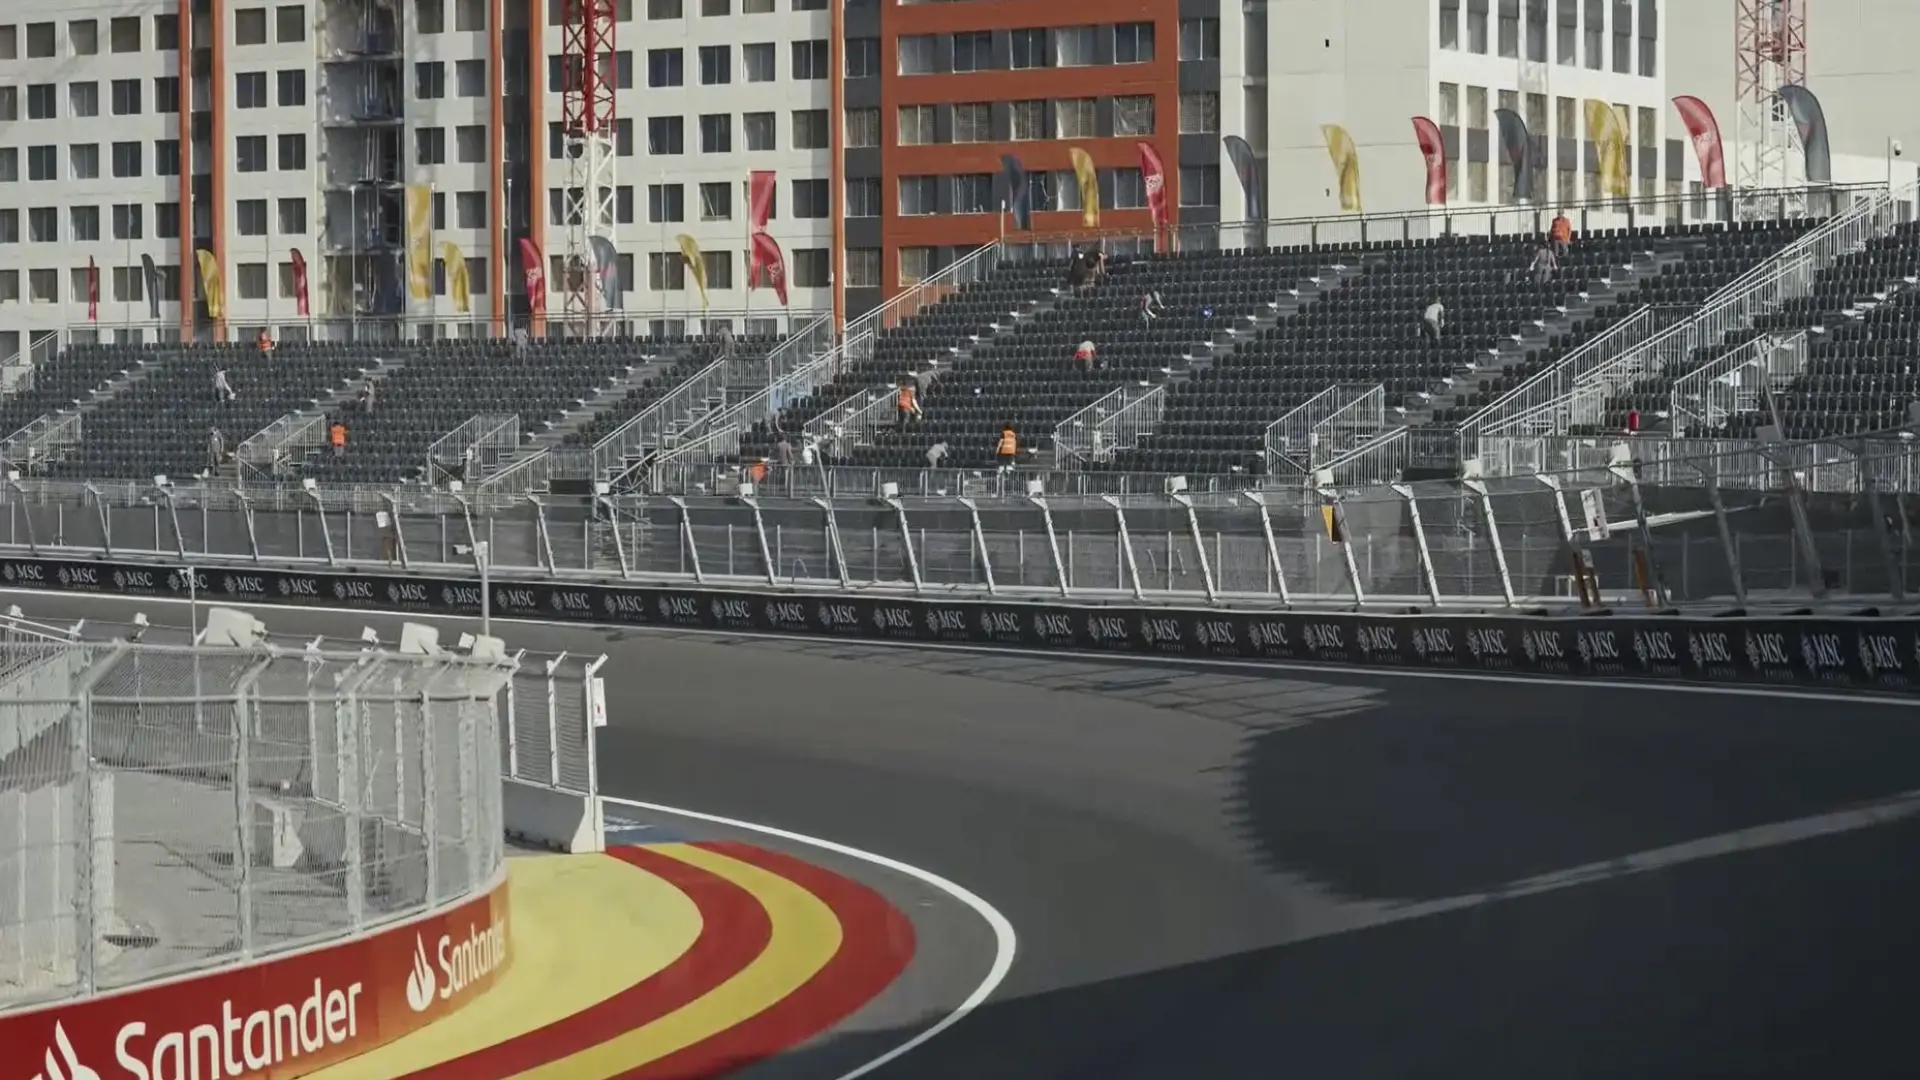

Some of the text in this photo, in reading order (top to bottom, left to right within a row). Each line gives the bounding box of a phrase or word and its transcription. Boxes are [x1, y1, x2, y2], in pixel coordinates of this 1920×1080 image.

[16, 565, 45, 580] MSC
[71, 567, 99, 583] MSC
[126, 571, 154, 586] MSC
[237, 577, 265, 592] MSC
[291, 579, 318, 594] MSC
[346, 581, 375, 597] MSC
[400, 584, 429, 600] MSC
[455, 587, 482, 604] MSC
[508, 590, 537, 606] MSC
[563, 592, 591, 609] MSC
[616, 595, 644, 612] MSC
[671, 597, 699, 615] MSC
[722, 600, 752, 618] MSC
[777, 603, 806, 621] MSC
[830, 605, 859, 624] MSC
[885, 608, 914, 627] MSC
[937, 610, 966, 629] MSC
[992, 612, 1021, 632] MSC
[1045, 614, 1074, 635] MSC
[1099, 617, 1128, 638] MSC
[1153, 619, 1182, 640] MSC
[1208, 621, 1236, 643] MSC
[1260, 622, 1289, 645] MSC
[1314, 624, 1344, 647] MSC
[1368, 626, 1398, 650] MSC
[1424, 628, 1455, 652] MSC
[1478, 629, 1509, 654] MSC
[1534, 630, 1565, 657] MSC
[1589, 631, 1620, 658] MSC
[1643, 631, 1677, 660] MSC
[1699, 632, 1732, 662] MSC
[1756, 633, 1789, 663] MSC
[1811, 634, 1845, 666] MSC
[1869, 635, 1902, 668] MSC
[115, 977, 362, 1080] Santander
